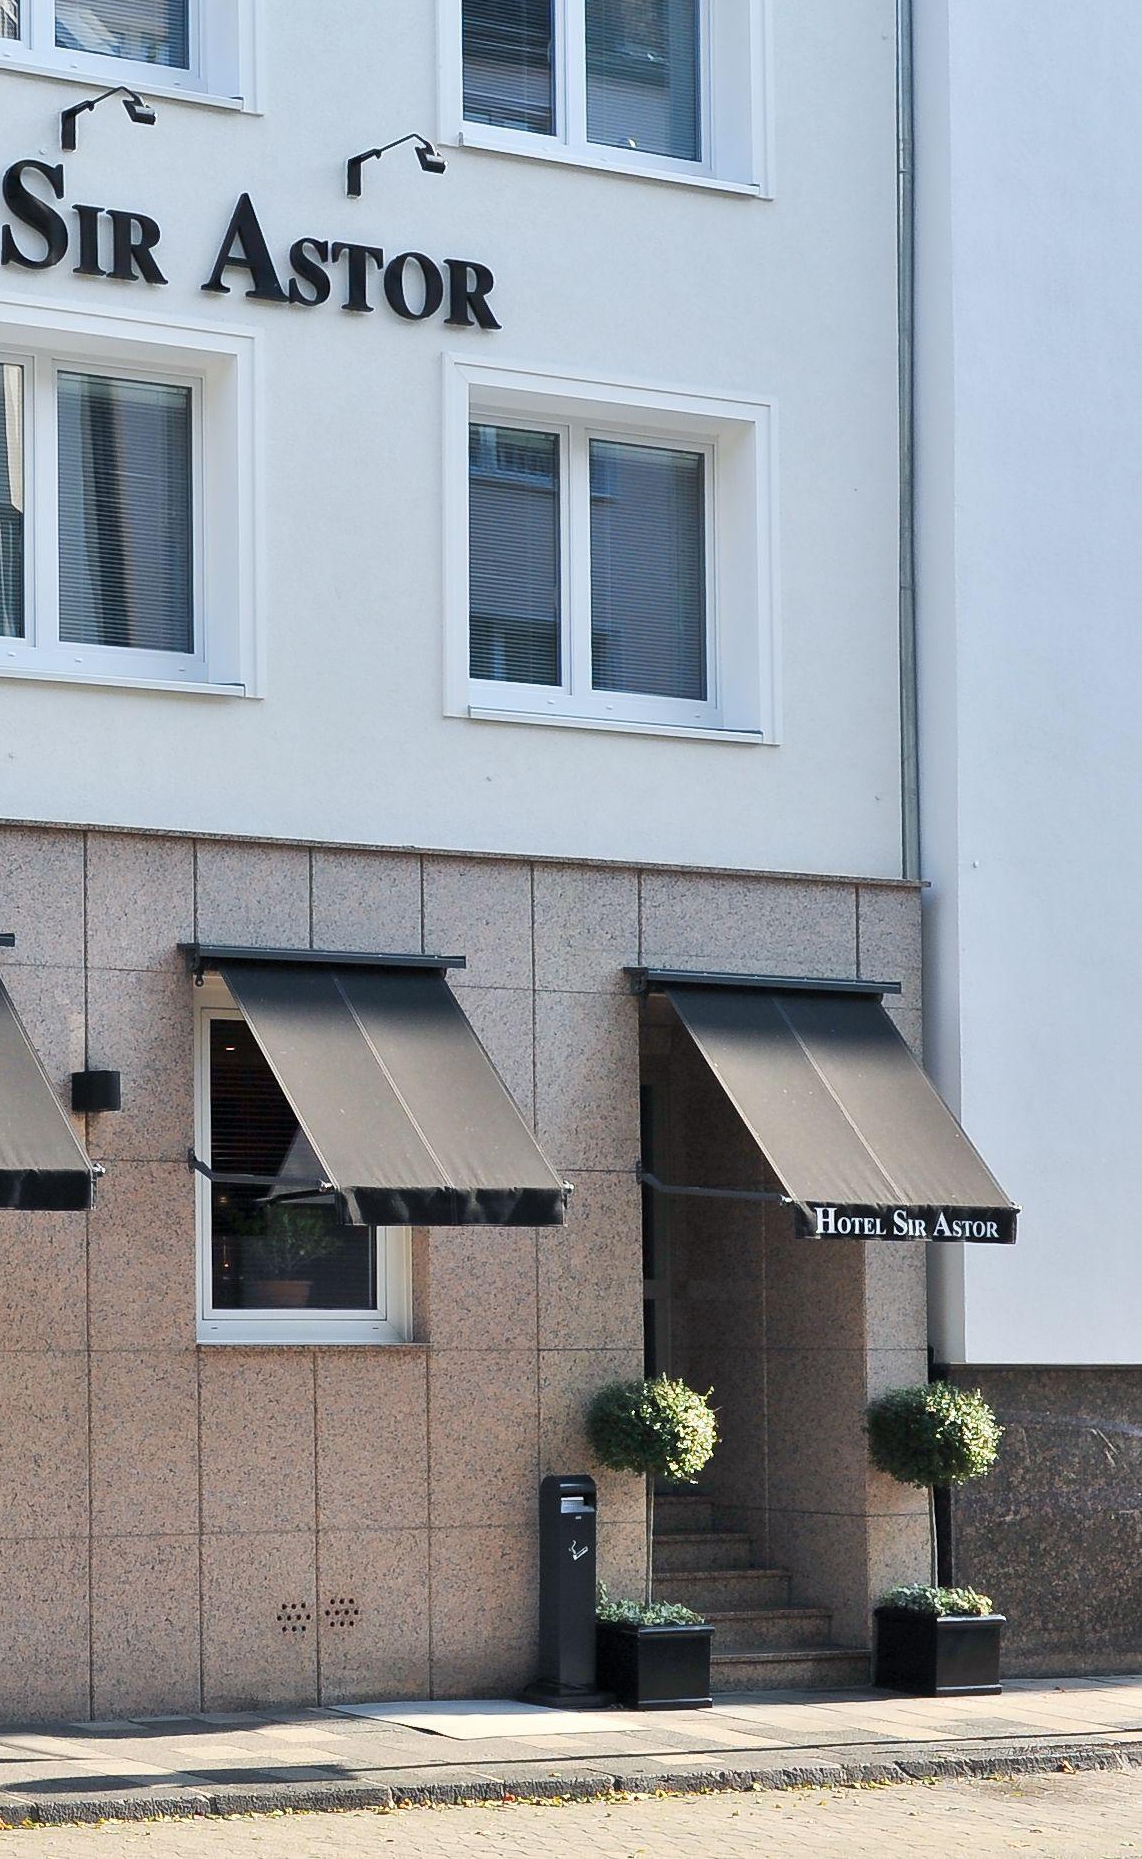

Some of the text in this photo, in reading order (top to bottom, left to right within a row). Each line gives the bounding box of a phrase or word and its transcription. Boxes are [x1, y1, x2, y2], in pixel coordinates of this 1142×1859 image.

[0, 159, 169, 285] SIR
[200, 192, 503, 330] ASTOR
[814, 1206, 1000, 1238] HOTEL SIR ASTOR
